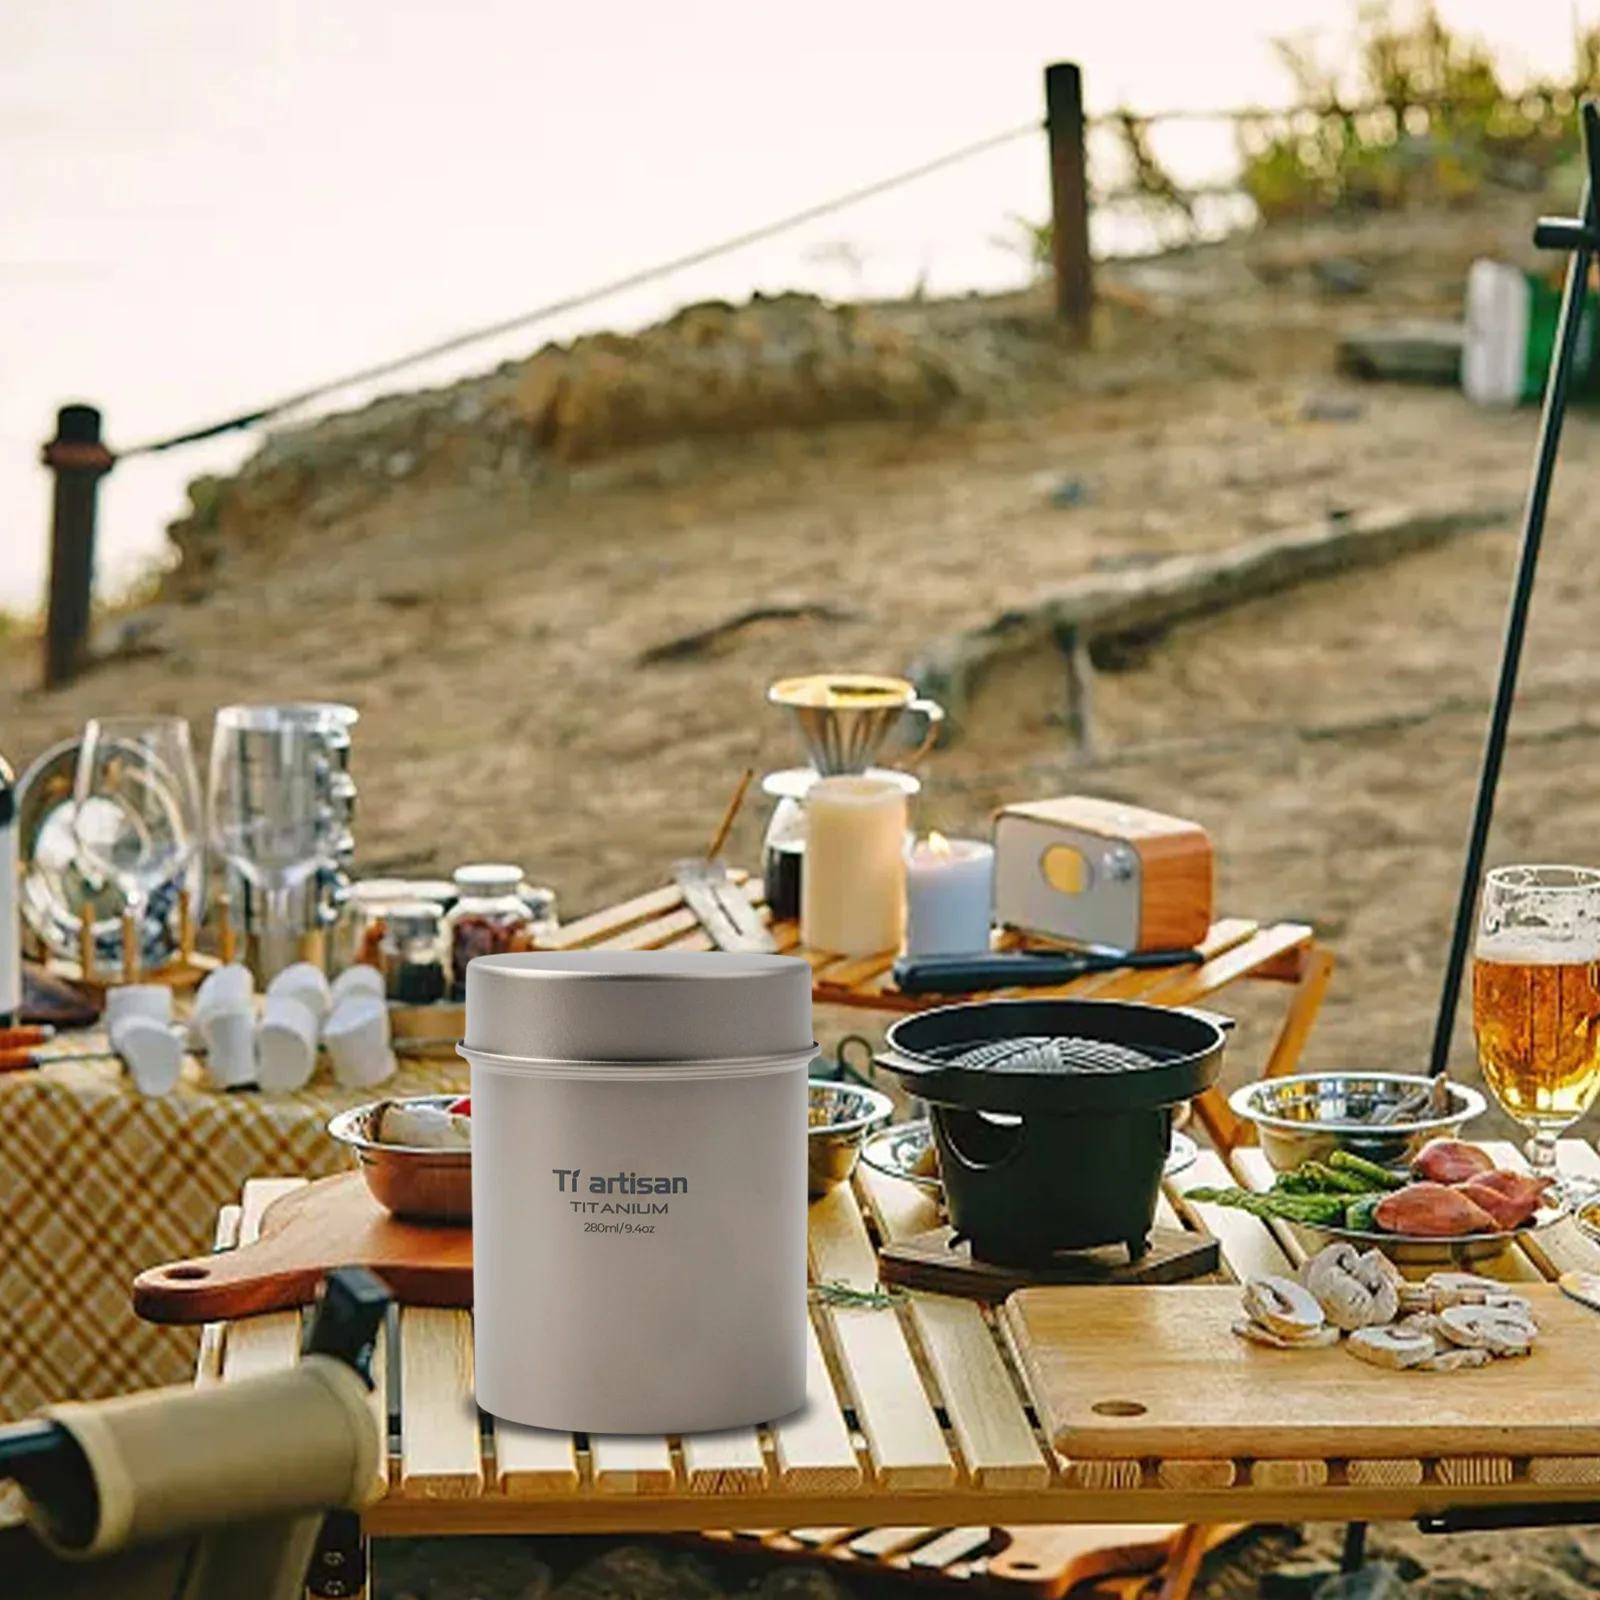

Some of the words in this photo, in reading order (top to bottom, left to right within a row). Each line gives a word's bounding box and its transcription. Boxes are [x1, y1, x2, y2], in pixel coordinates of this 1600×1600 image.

[552, 1169, 581, 1192] Ti
[589, 1172, 688, 1194] artisan
[570, 1201, 669, 1214] TITANIUM
[584, 1222, 655, 1234] 280ml/9.4oz
